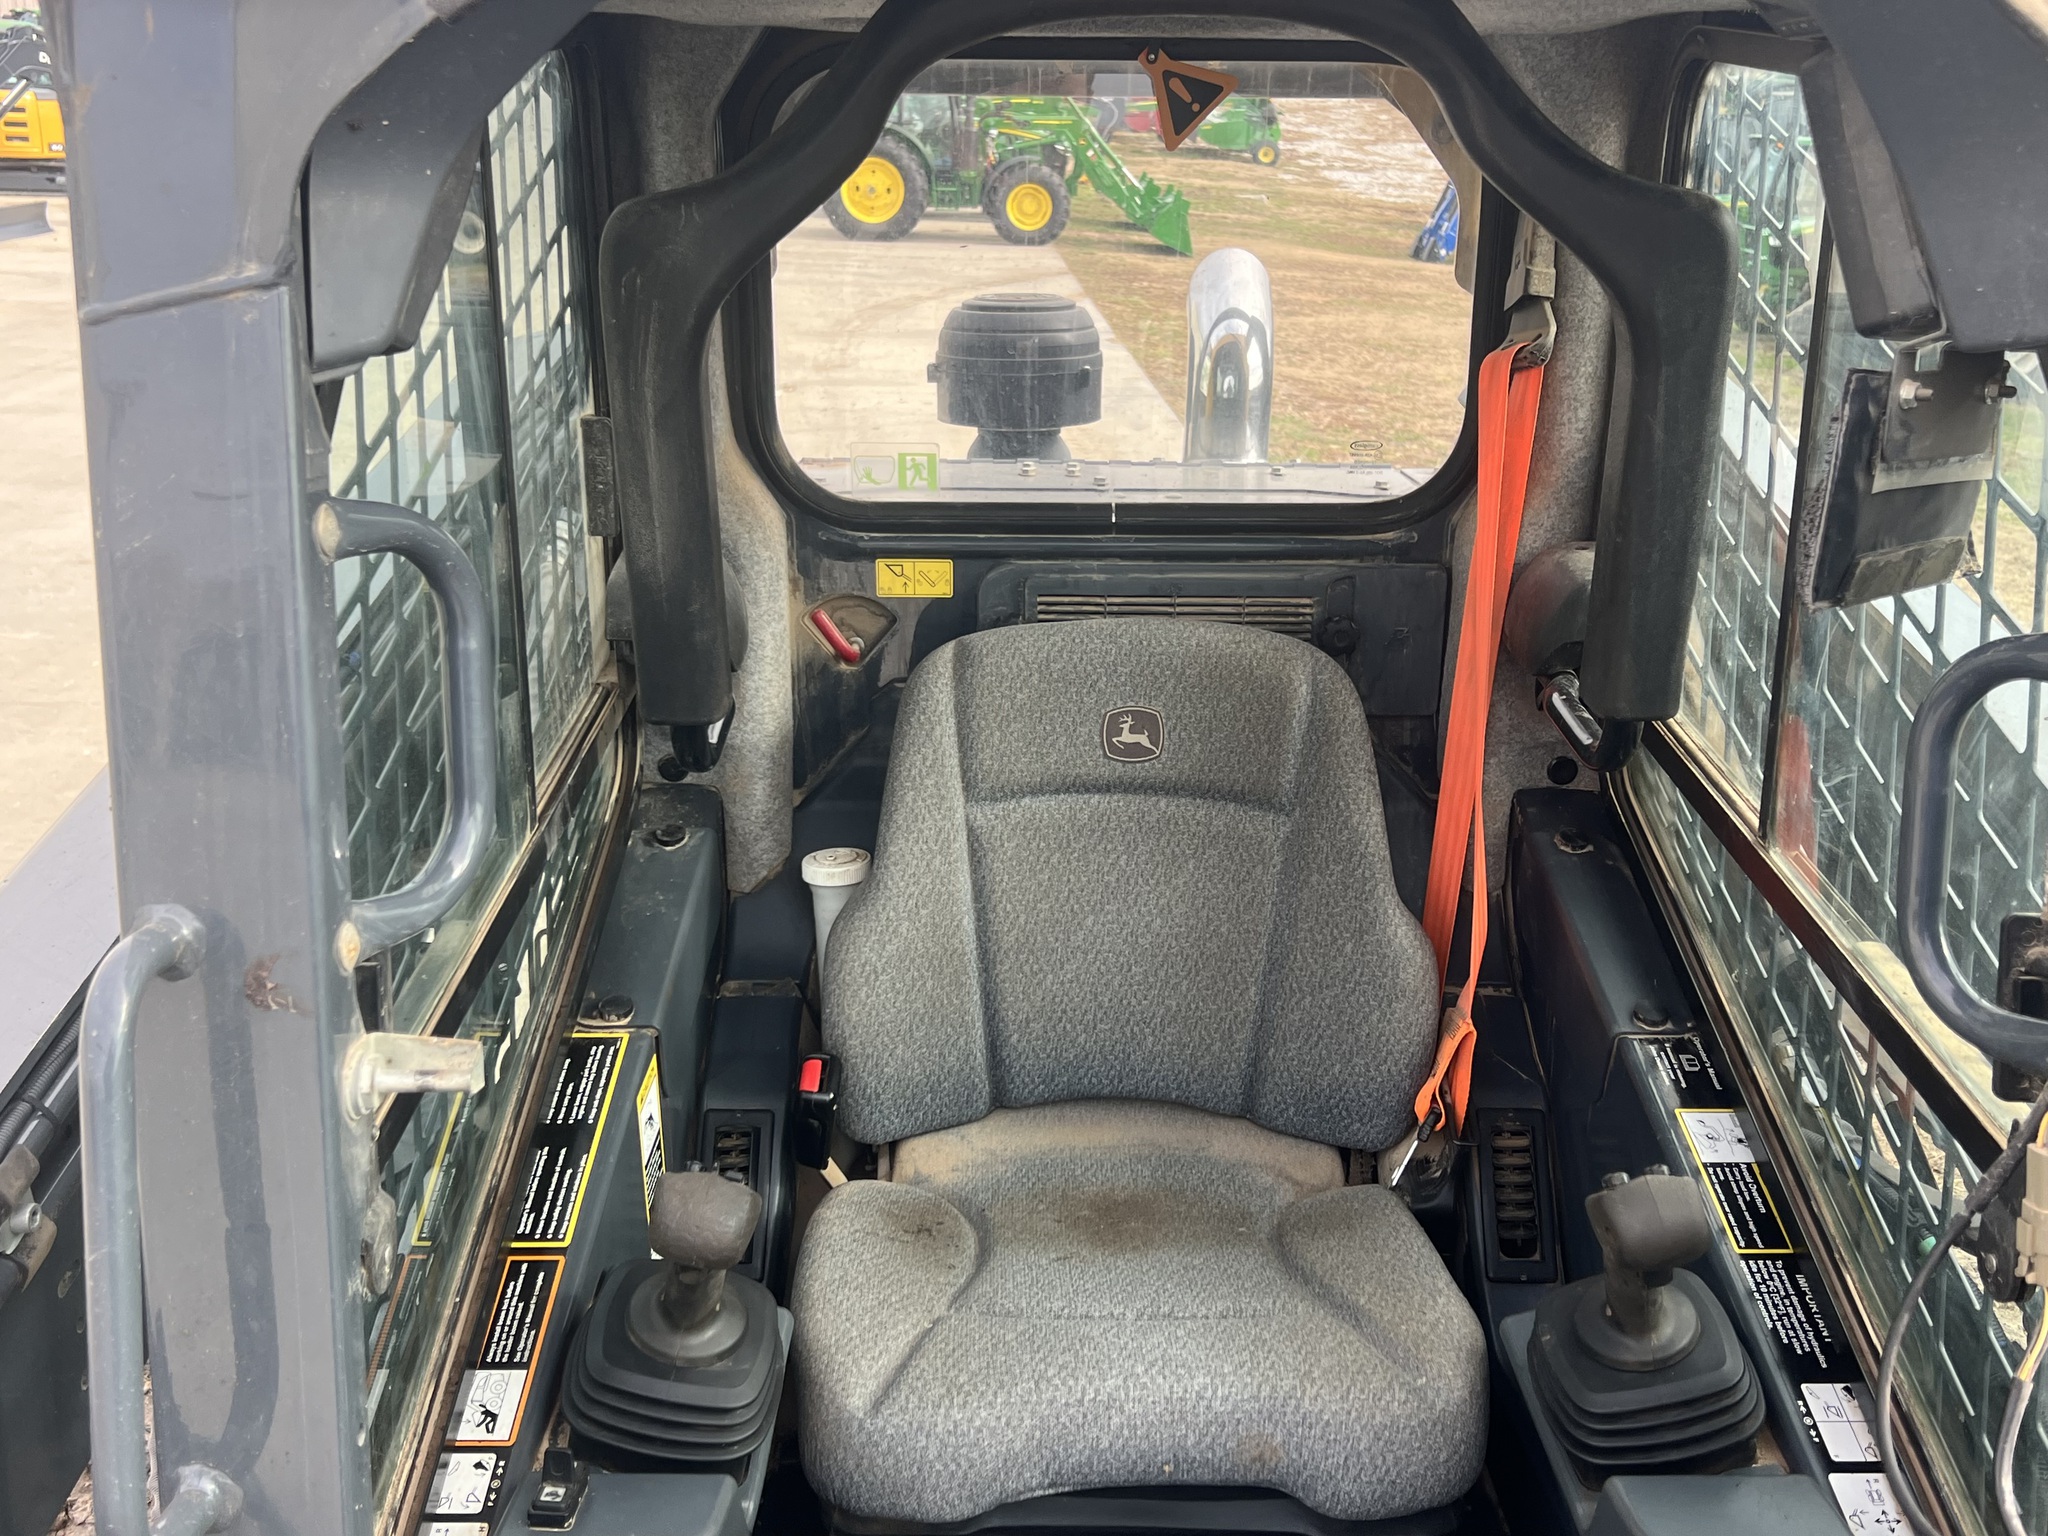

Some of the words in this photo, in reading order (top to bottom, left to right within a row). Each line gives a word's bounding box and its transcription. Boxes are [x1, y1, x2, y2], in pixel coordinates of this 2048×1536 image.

[1693, 1037, 1710, 1067] Operator's
[1707, 1068, 1722, 1089] Manual
[1724, 1167, 1734, 1181] Avoid
[1748, 1221, 1756, 1232] high
[1733, 1167, 1741, 1180] Carry
[1739, 1181, 1747, 1191] load
[1739, 1163, 1754, 1182] Avoid
[1749, 1184, 1766, 1213] Overturn
[1738, 1259, 1757, 1291] operation
[1757, 1300, 1773, 1330] controls.
[1748, 1260, 1757, 1272] idle
[1763, 1293, 1778, 1320] minutes
[1775, 1321, 1788, 1343] before
[1757, 1260, 1770, 1279] below
[1791, 1338, 1803, 1354] slow
[1766, 1260, 1777, 1272] and
[1787, 1307, 1810, 1352] temperatures
[1778, 1270, 1795, 1294] prevent
[1791, 1295, 1806, 1322] damage
[1807, 1332, 1827, 1368] hydraulics
[517, 1324, 530, 1351] Operator's
